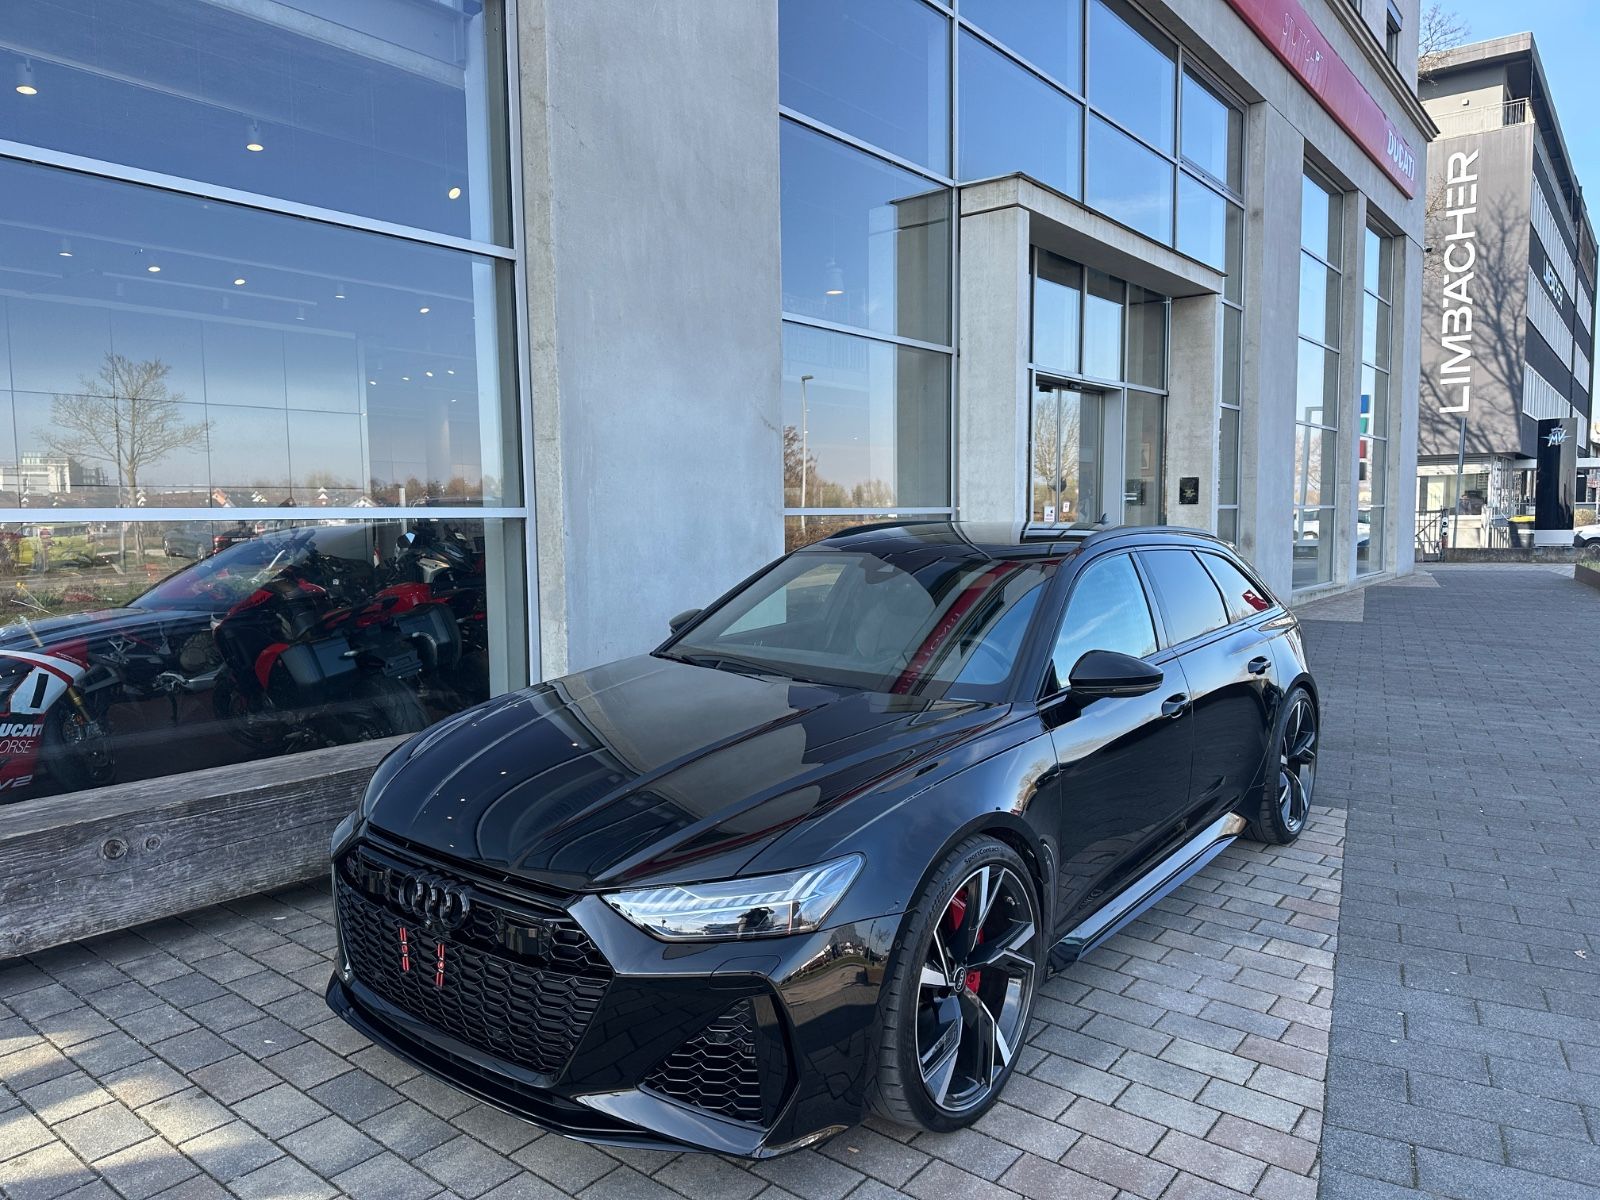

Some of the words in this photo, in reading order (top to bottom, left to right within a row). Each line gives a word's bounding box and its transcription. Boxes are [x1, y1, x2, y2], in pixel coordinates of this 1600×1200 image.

[1386, 129, 1415, 182] DUCATI
[1439, 148, 1479, 414] LIMBÄCHER
[0, 723, 43, 737] UCATI
[0, 739, 34, 754] ORSE
